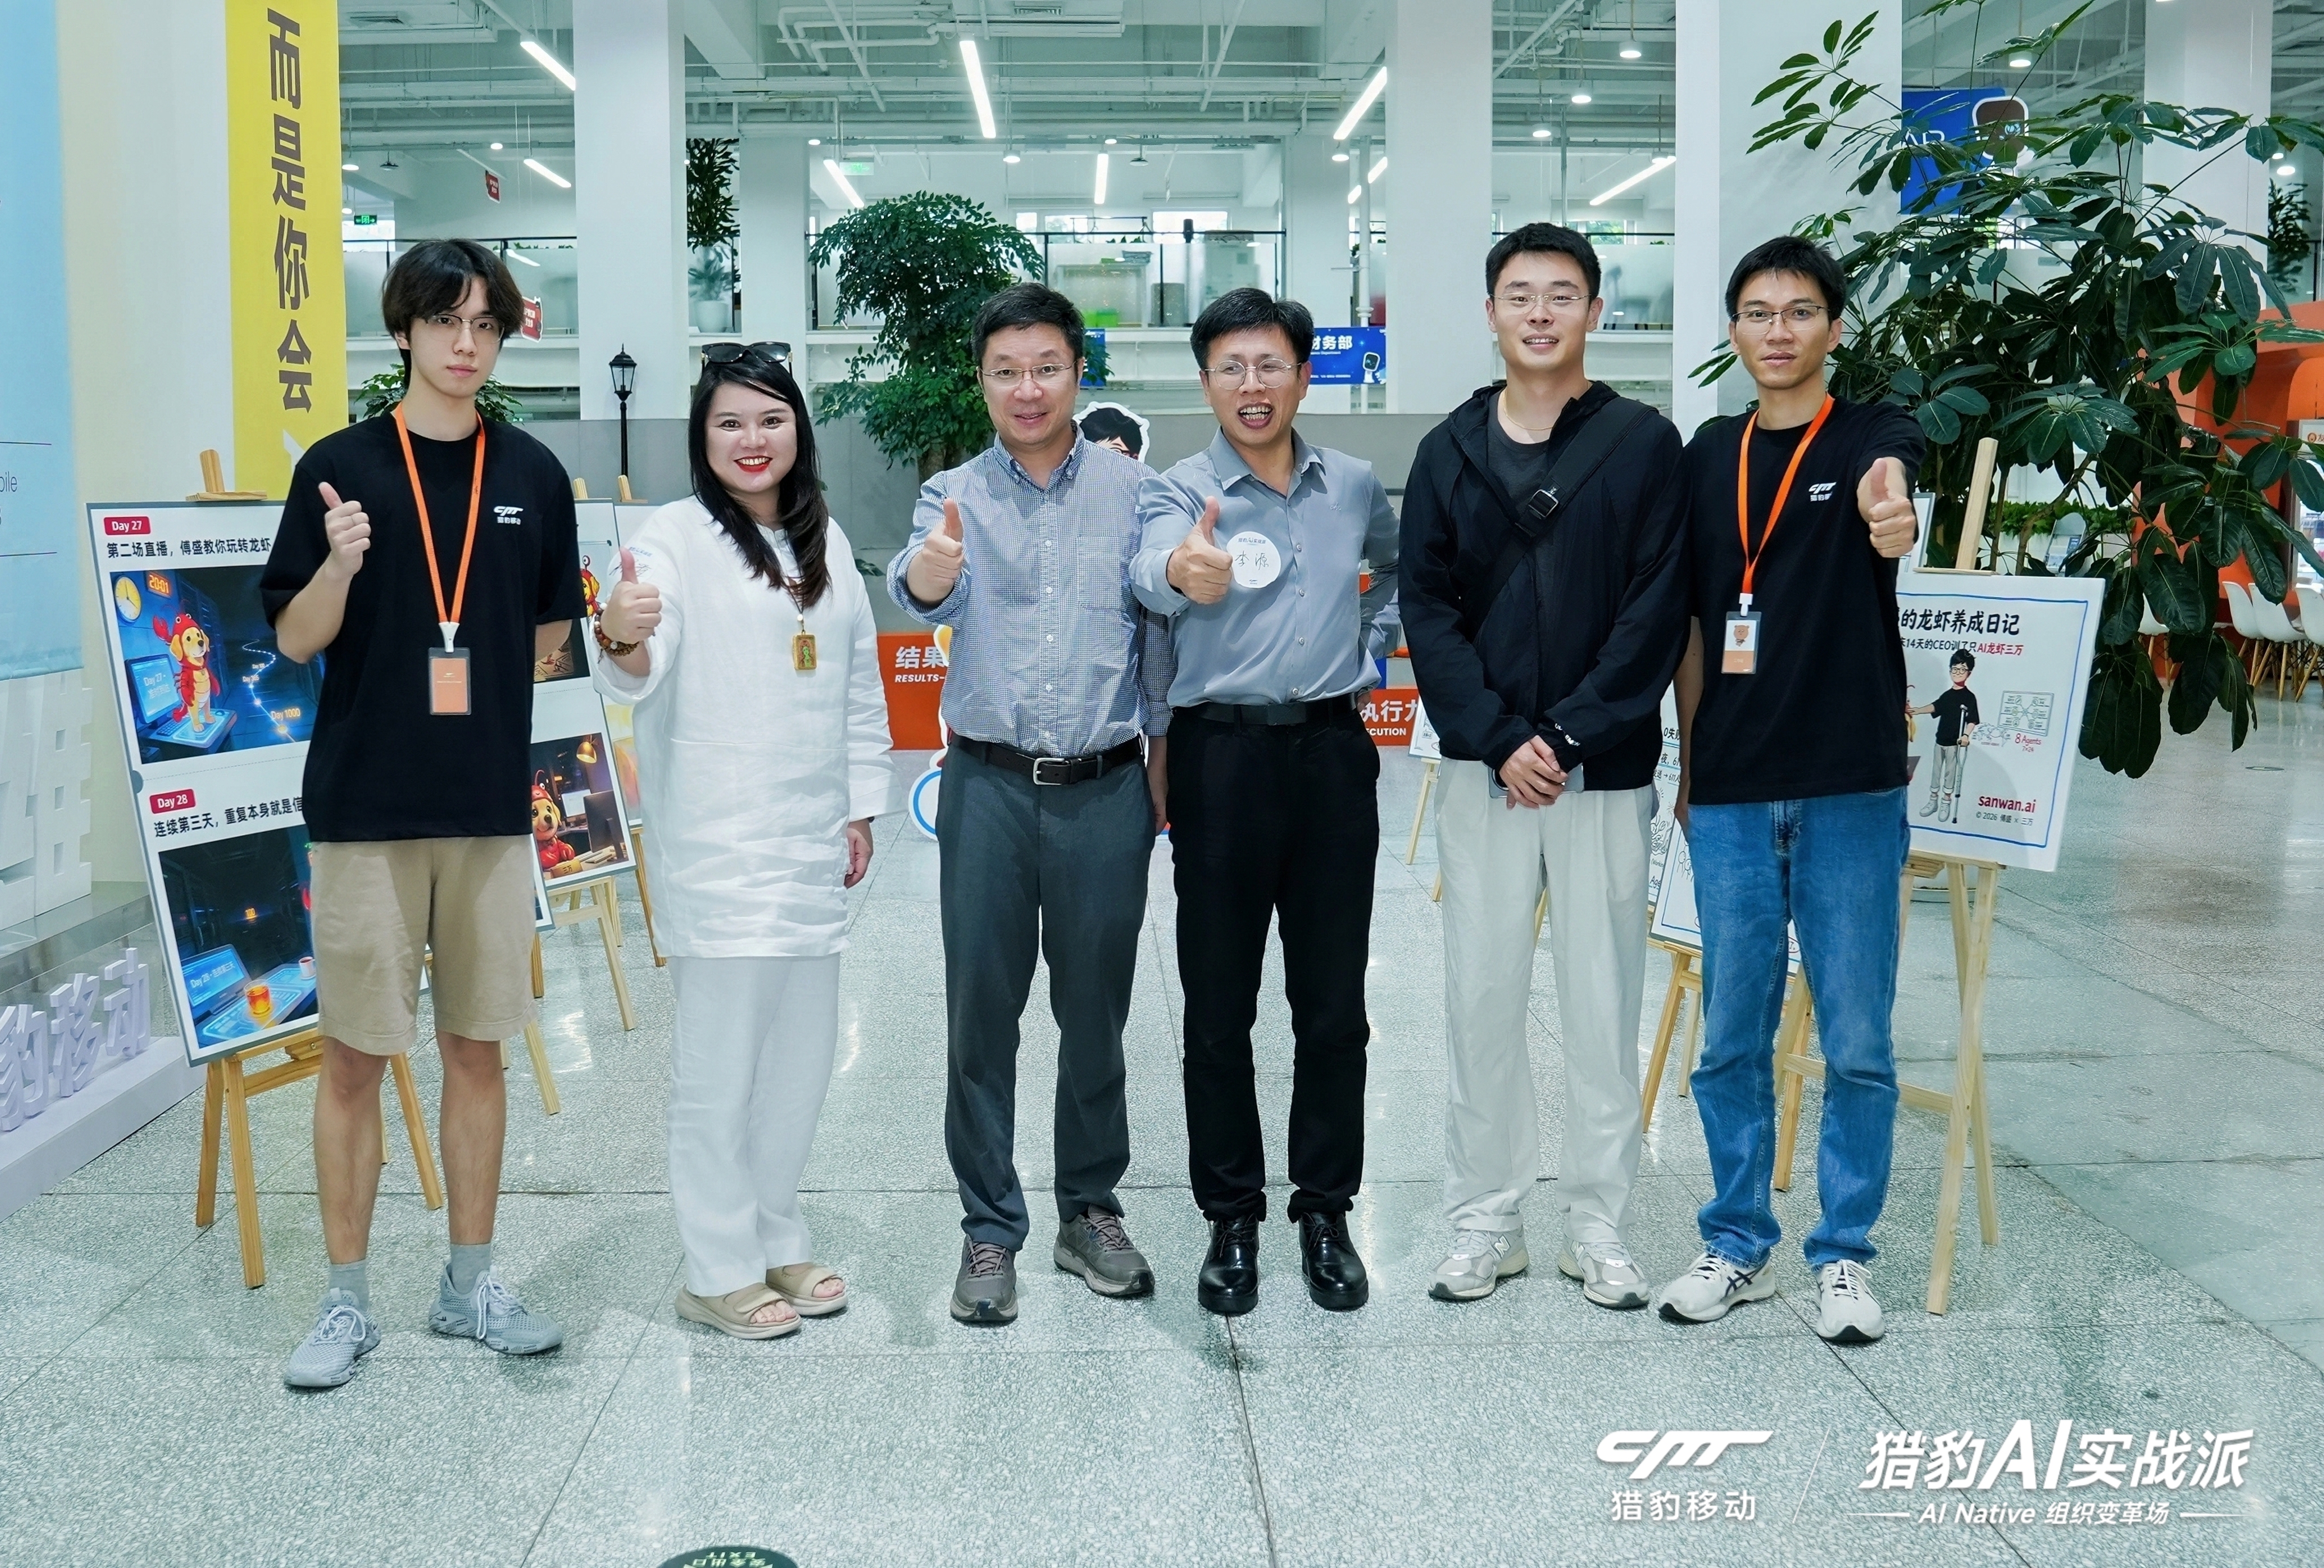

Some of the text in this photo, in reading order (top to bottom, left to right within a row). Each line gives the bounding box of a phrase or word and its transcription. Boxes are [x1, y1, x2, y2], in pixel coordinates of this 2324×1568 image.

[267, 7, 312, 413] 而是你会
[111, 521, 142, 533] Day 27
[107, 538, 271, 558] 第二场直播，傅盛教你玩转龙虾
[149, 575, 169, 594] 20:01
[1897, 606, 2020, 636] 的龙虾养成日记
[895, 645, 945, 669] 结果
[143, 677, 155, 686] Day
[271, 708, 301, 720] Day 1000
[2015, 733, 2041, 746] 8 Agents
[157, 794, 188, 808] Day 28
[1978, 796, 2036, 813] sanwan.ai
[1983, 812, 1998, 821] 2026
[2021, 817, 2033, 826] 三万
[190, 978, 203, 988] Day
